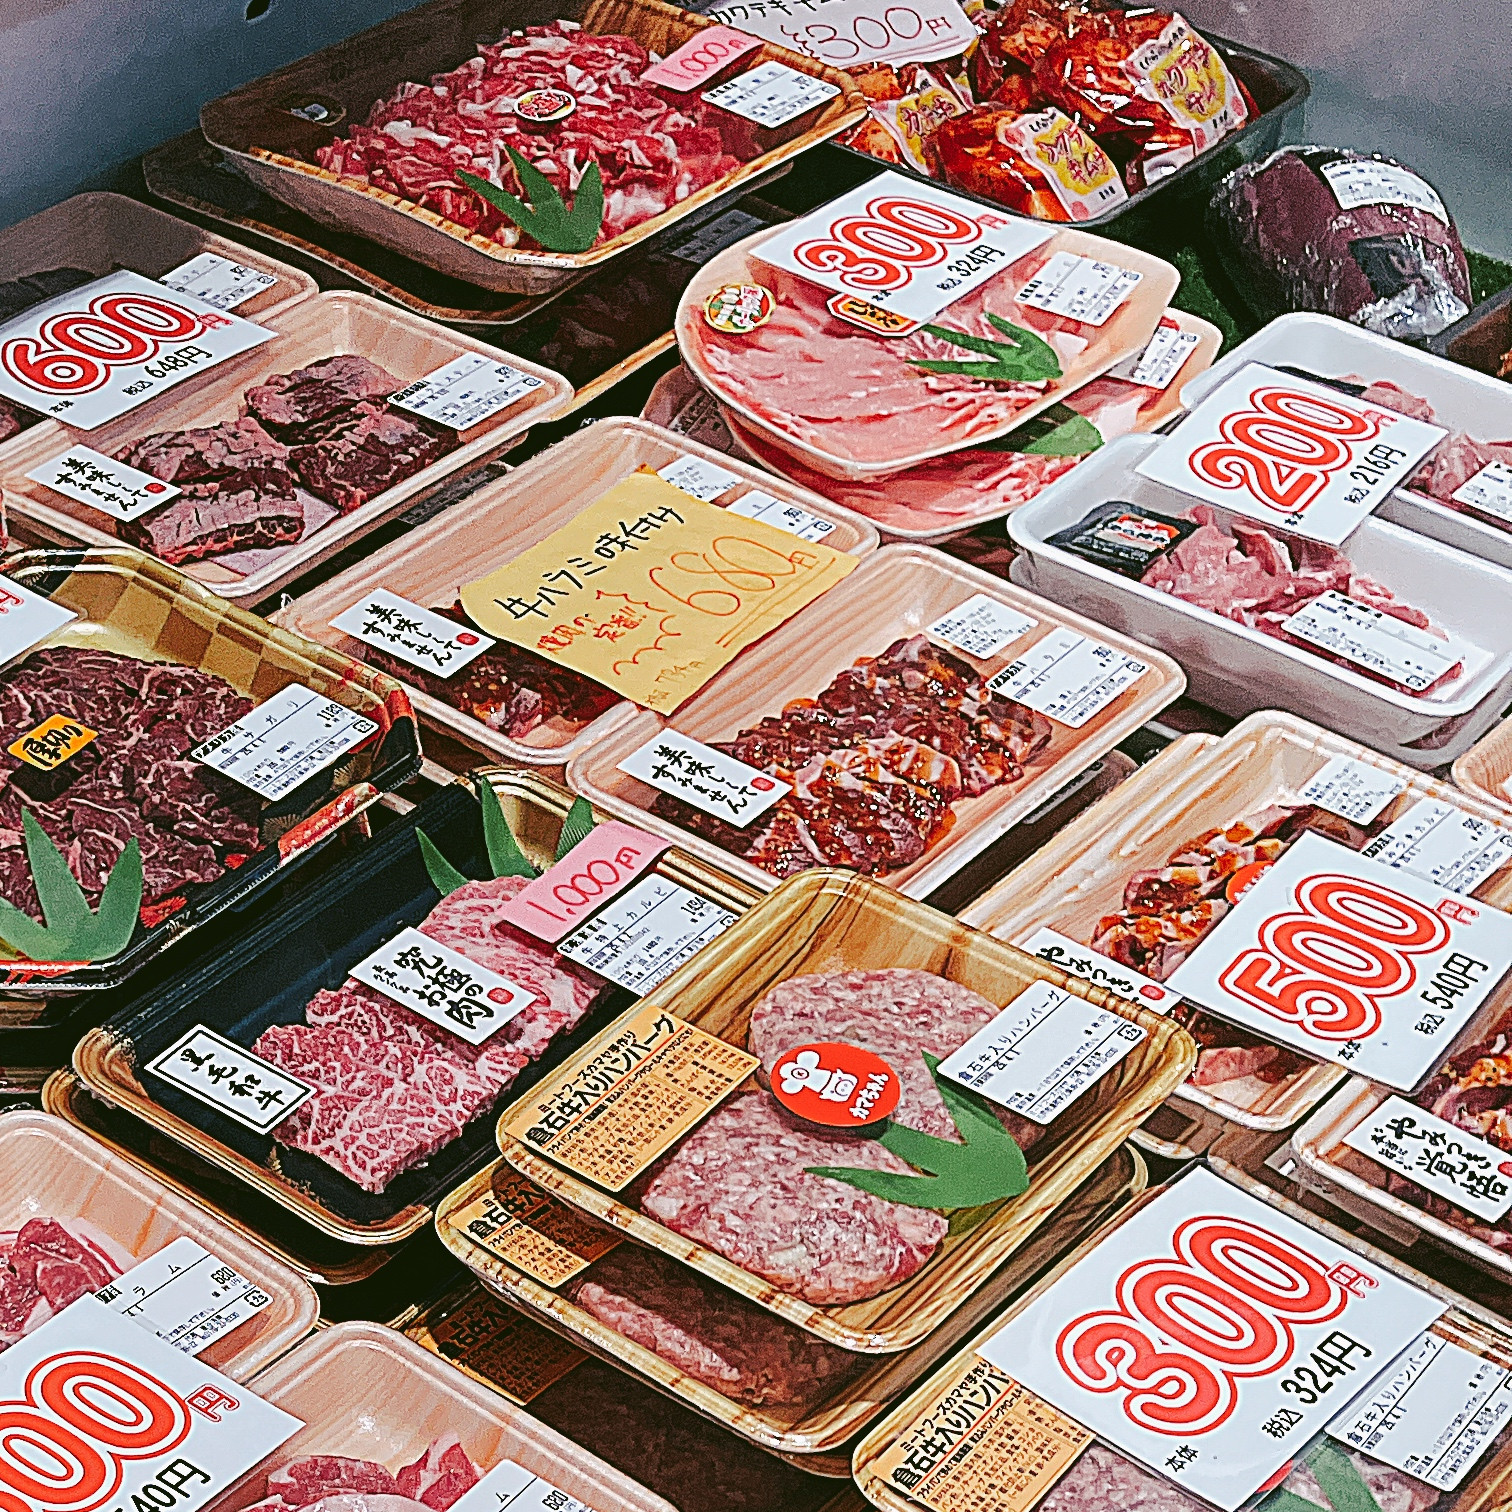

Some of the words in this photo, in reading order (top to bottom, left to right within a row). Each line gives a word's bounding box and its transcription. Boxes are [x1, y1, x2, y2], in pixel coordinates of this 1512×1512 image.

[794, 196, 1010, 290] 300円
[954, 245, 1006, 278] 324円
[1, 293, 233, 393] 600円
[143, 345, 213, 380] 648円
[1188, 382, 1400, 513] 200円
[1362, 443, 1408, 485] 216円
[22, 726, 86, 768] 厚切り
[533, 845, 644, 924] 1,000円
[1219, 873, 1483, 1043] 500円
[1427, 951, 1489, 1010] 540円
[1052, 1216, 1378, 1437] 300円
[1280, 1330, 1373, 1405] 324円
[1260, 1407, 1305, 1441] 税込
[1163, 1443, 1201, 1475] 本体
